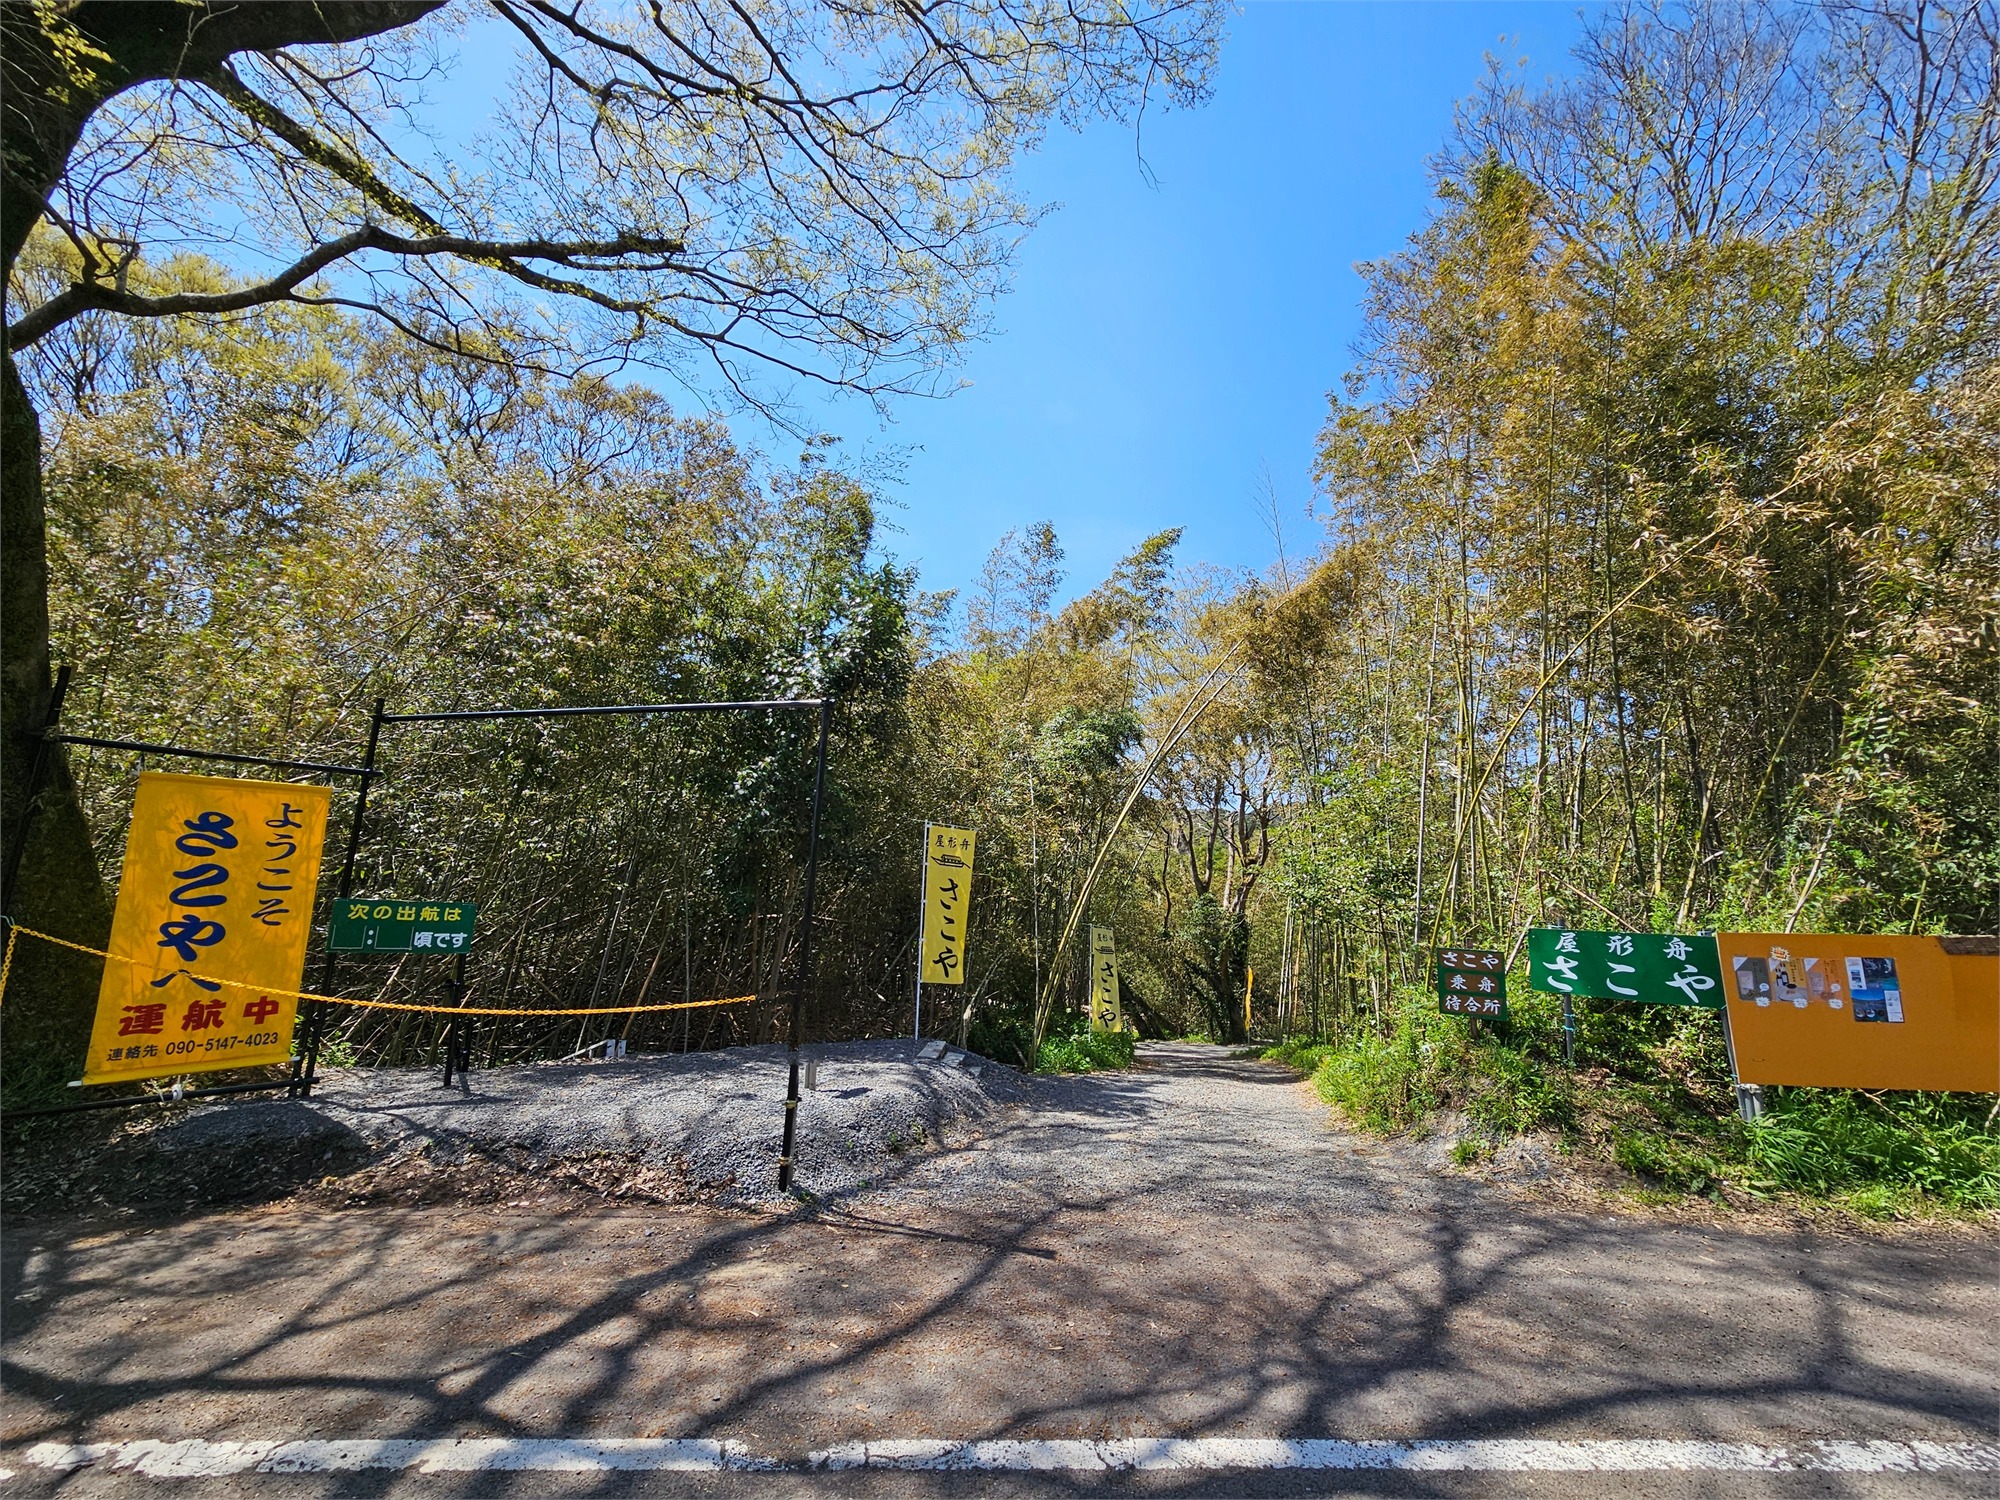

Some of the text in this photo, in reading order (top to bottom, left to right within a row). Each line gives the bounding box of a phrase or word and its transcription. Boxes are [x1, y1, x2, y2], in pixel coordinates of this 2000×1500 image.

[251, 802, 304, 926] ようこそ
[150, 811, 239, 992] さこやへ
[347, 903, 462, 921] 次の出航は
[413, 931, 468, 948] 頃です
[932, 878, 959, 978] さこや
[1441, 951, 1499, 969] さこや
[1554, 932, 1694, 961] 屋形舟
[1450, 975, 1496, 993] 乗舟
[1542, 955, 1716, 1004] さこや
[1097, 962, 1117, 1028] さこや
[1444, 994, 1501, 1015] 待合所
[117, 995, 280, 1037] 運航中
[106, 1032, 279, 1062] 連絡先 090-5147-4023
